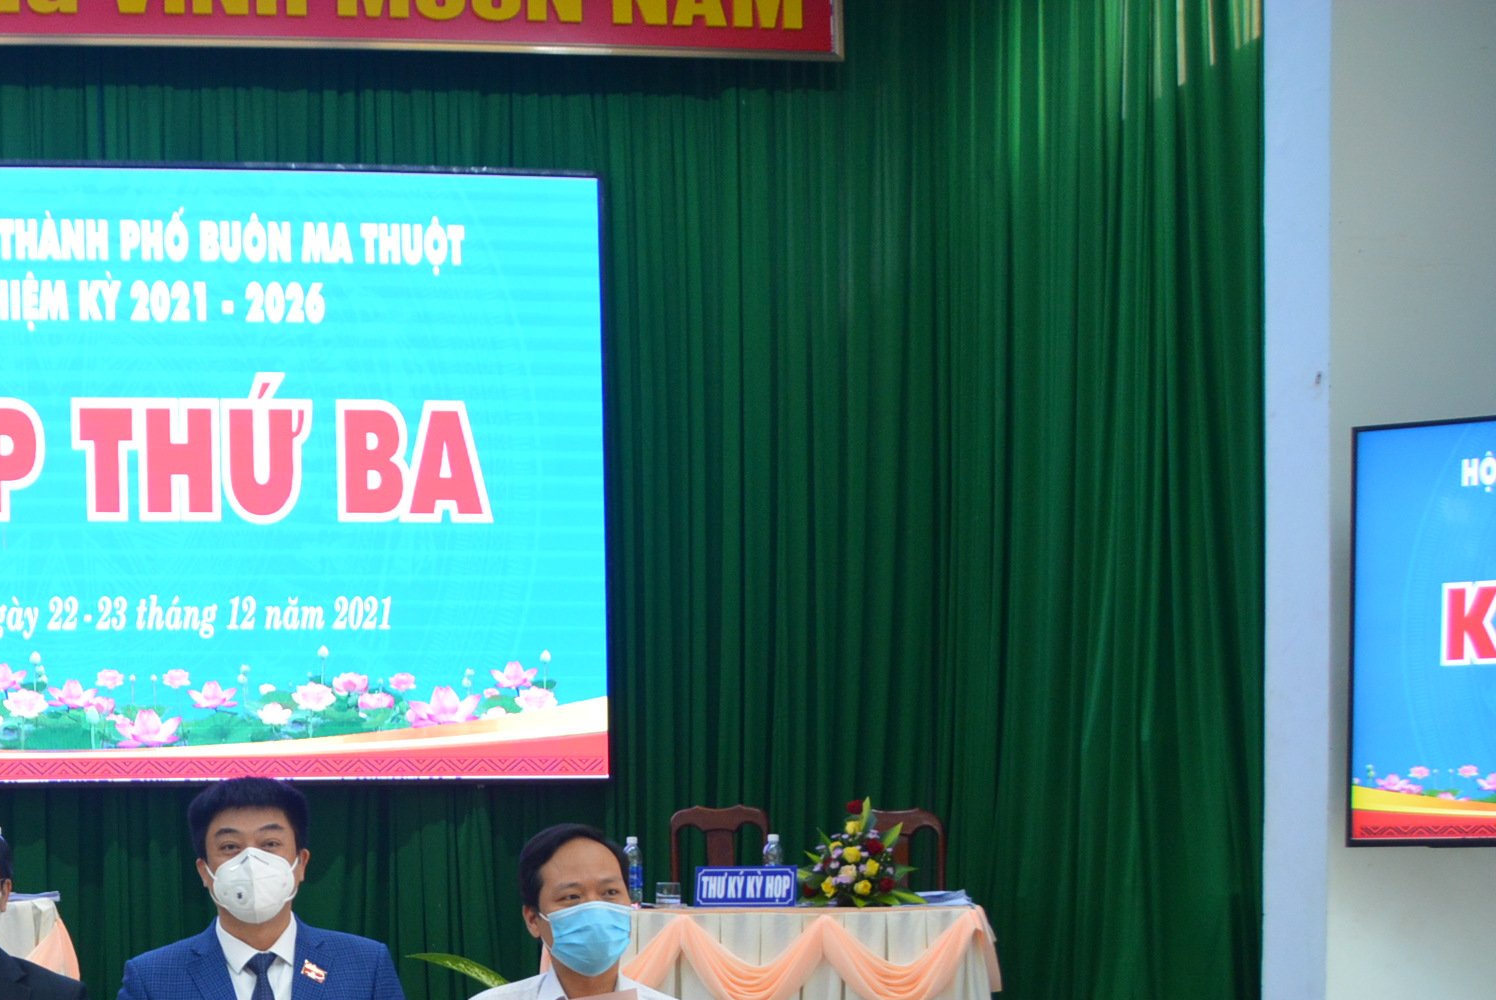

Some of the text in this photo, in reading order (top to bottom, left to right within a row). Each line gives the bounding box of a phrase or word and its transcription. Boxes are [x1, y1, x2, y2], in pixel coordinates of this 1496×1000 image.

[119, 206, 190, 263] PHỐ
[199, 212, 293, 264] BUÔN
[301, 221, 355, 264] MA
[360, 215, 466, 276] THUỘT
[78, 270, 122, 322] KỲ
[129, 279, 208, 323] 2021
[245, 280, 326, 325] 2026
[70, 371, 314, 526] THỨ
[335, 398, 495, 524] BA
[135, 594, 218, 639] tháng
[226, 596, 257, 630] 12
[264, 596, 326, 631] năm
[332, 596, 392, 631] 2021
[702, 870, 791, 903] THƯ KÝ KỲ HỌP
